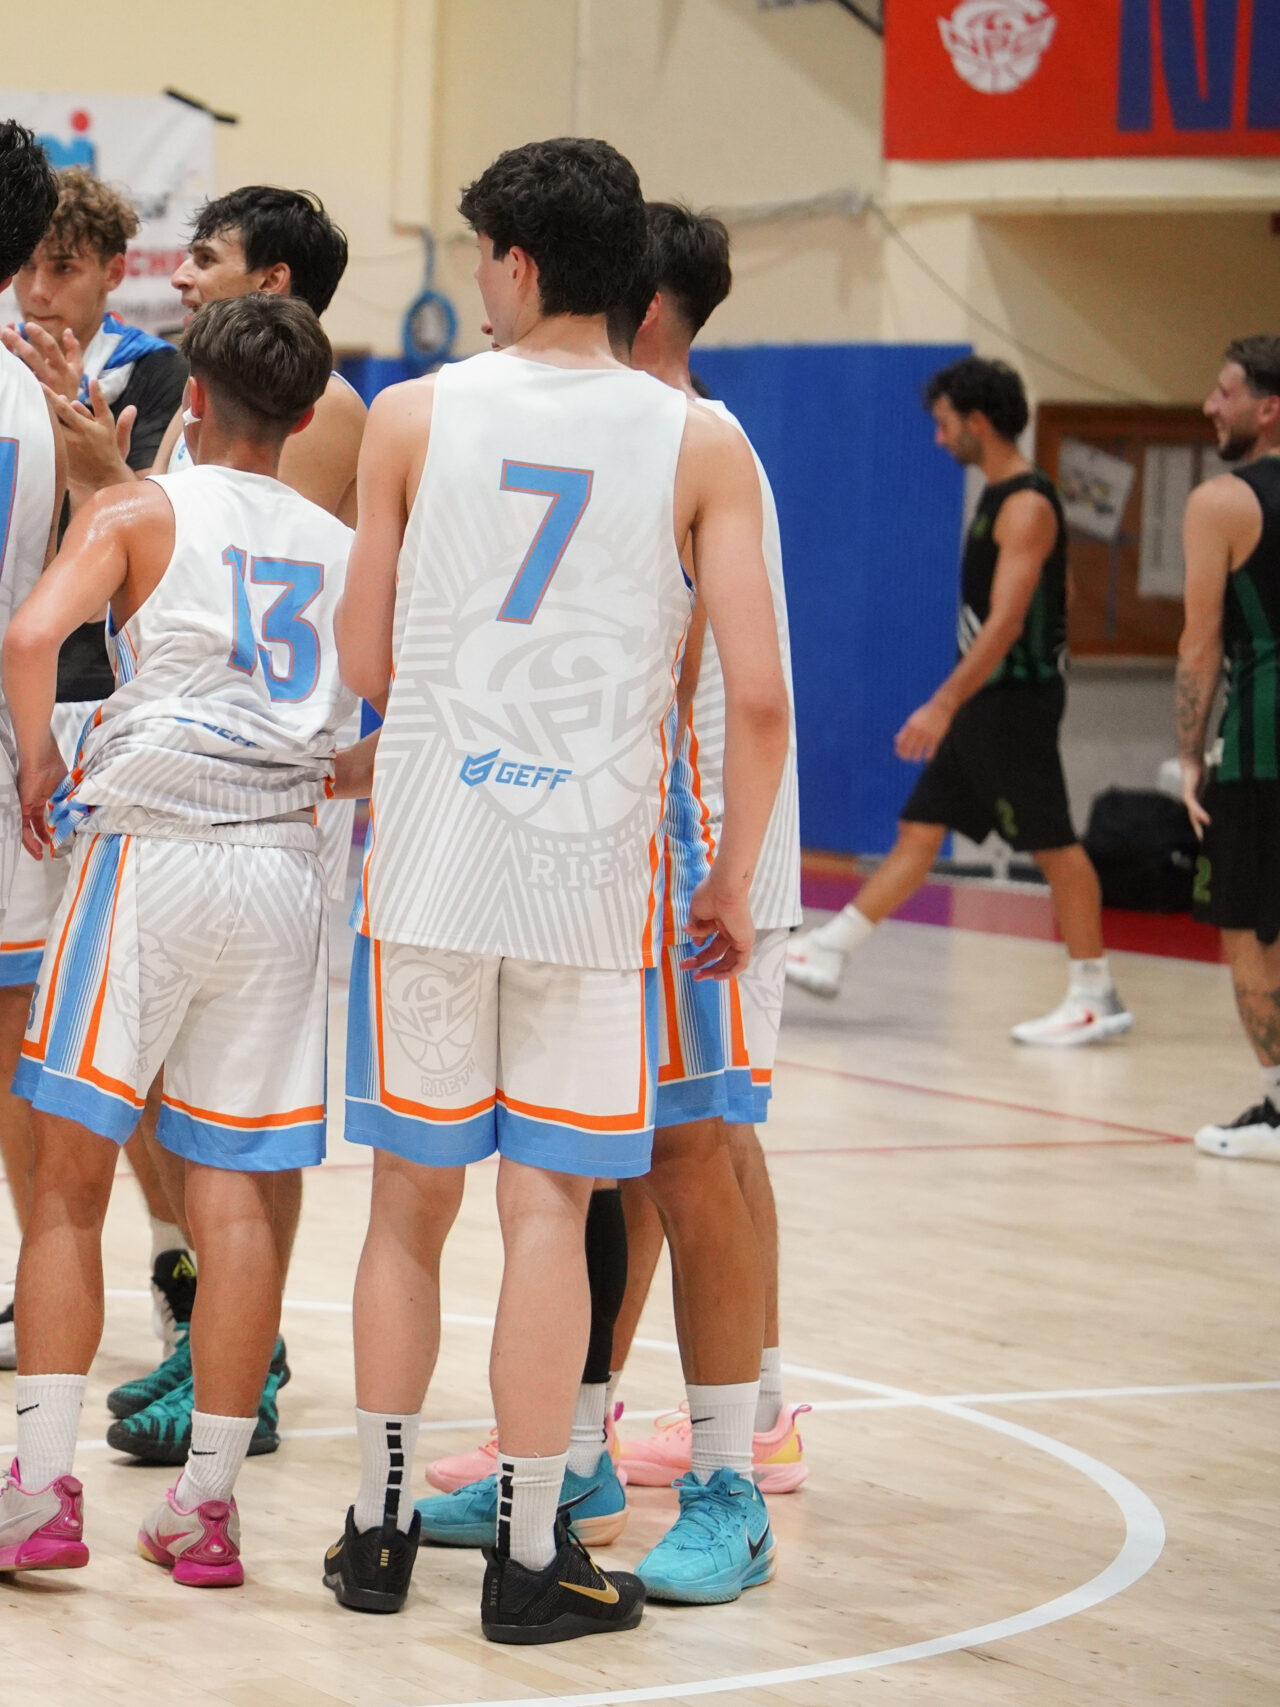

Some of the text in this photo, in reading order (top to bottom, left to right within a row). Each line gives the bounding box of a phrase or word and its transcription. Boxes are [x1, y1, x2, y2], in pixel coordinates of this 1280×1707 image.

[496, 458, 594, 624] 7
[221, 544, 325, 703] 13
[495, 762, 573, 790] GEFF
